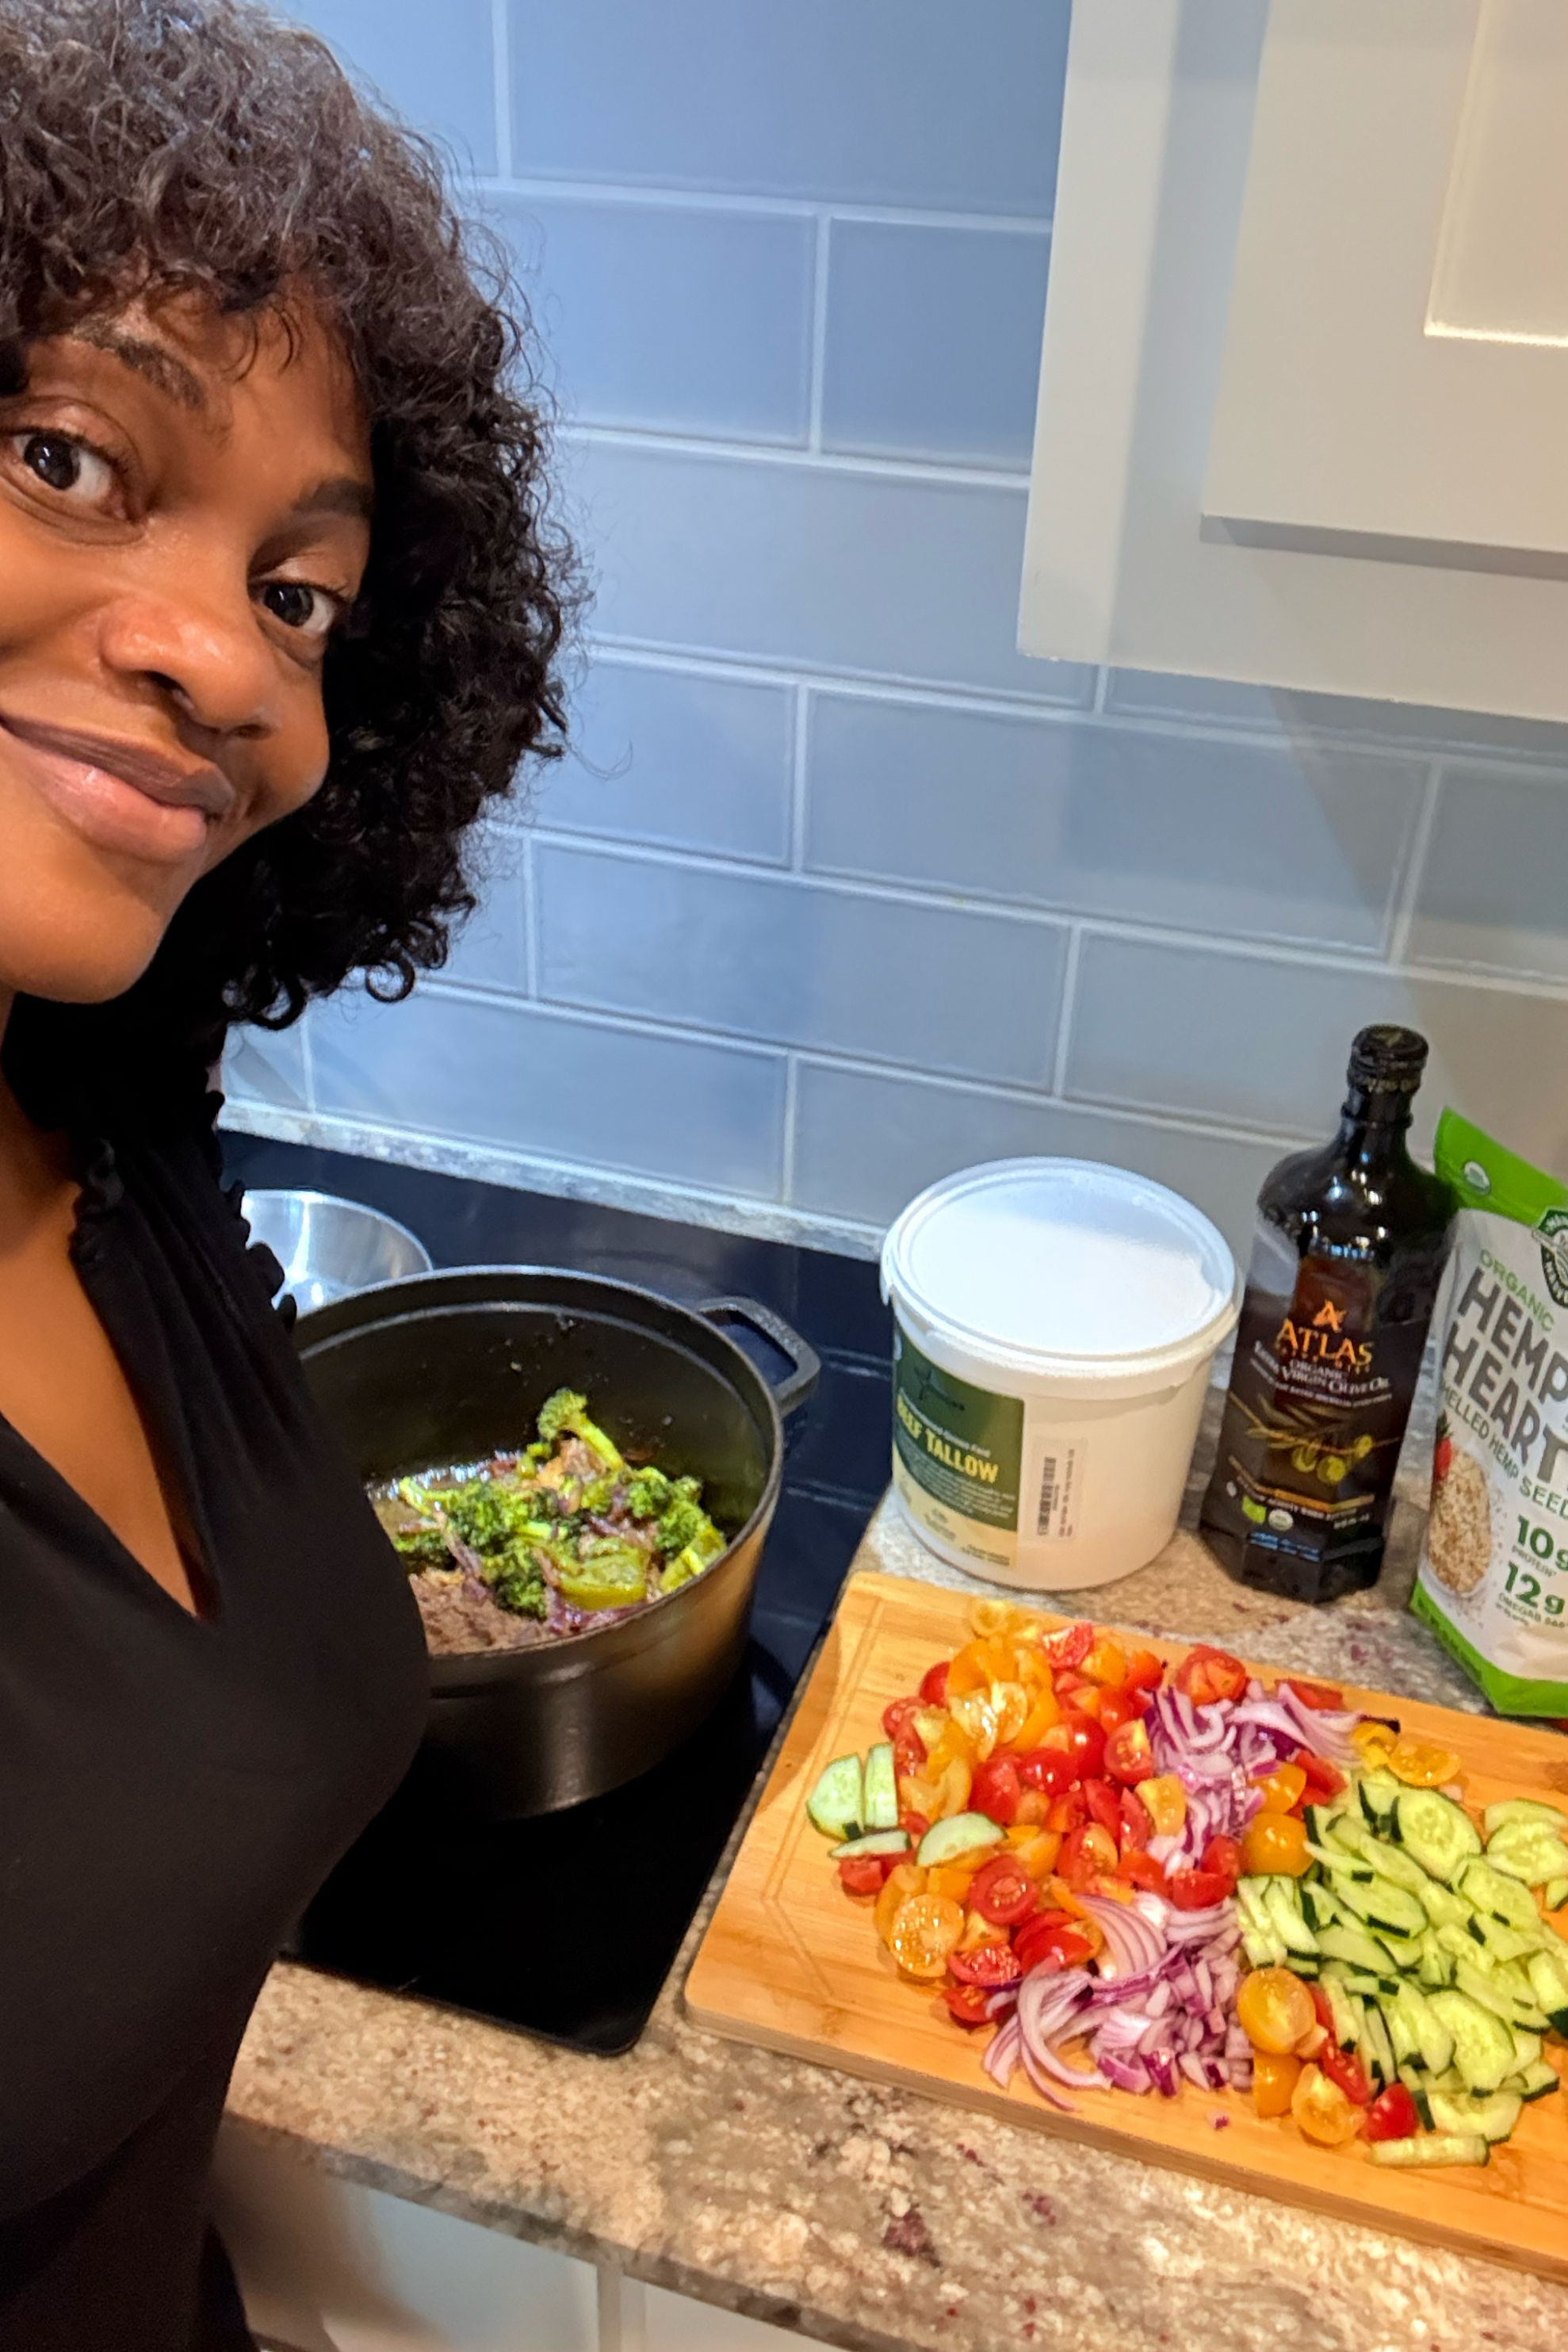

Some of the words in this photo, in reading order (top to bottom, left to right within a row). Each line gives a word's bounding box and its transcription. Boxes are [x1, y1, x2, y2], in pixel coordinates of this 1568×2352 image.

[1479, 1249, 1555, 1333] ORGANIC
[1274, 1318, 1375, 1367] ATLAS
[1457, 1266, 1568, 1405] HEMP
[1441, 1381, 1490, 1440] HELLED
[1488, 1434, 1520, 1480] HEMP
[1442, 1321, 1568, 1484] HEART
[925, 1428, 999, 1484] TALLOW
[1517, 1513, 1568, 1571] 10g
[1505, 1559, 1565, 1615] 12g
